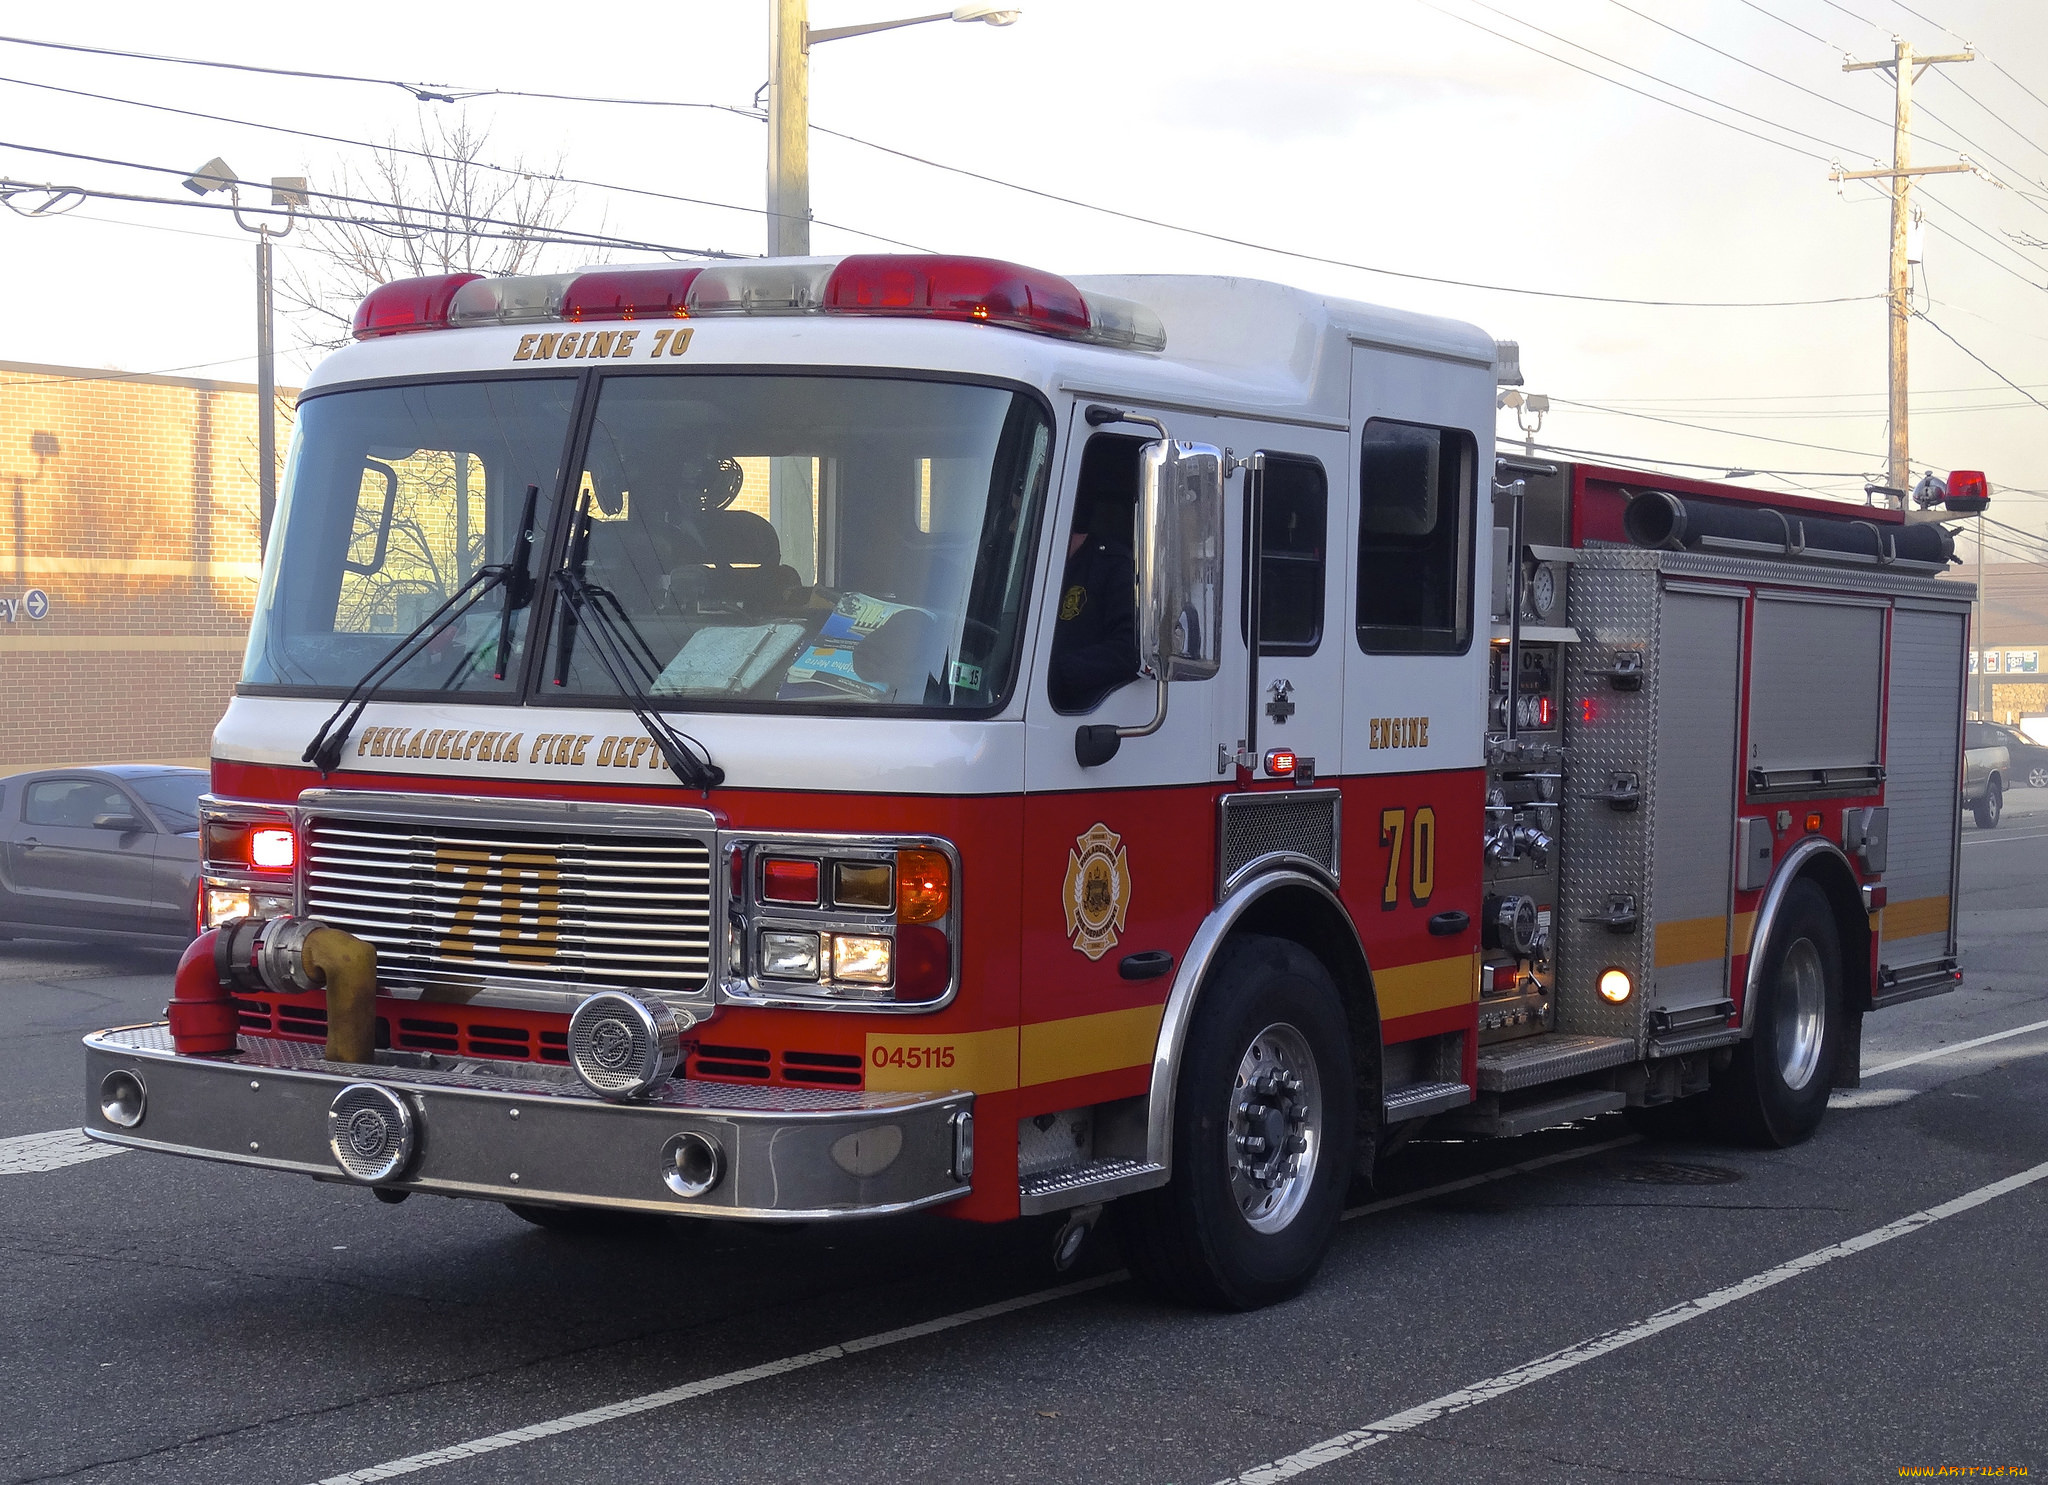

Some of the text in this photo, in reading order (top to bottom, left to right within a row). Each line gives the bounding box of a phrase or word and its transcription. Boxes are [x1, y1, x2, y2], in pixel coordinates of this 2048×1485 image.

[513, 327, 695, 361] ENGINE 70
[357, 726, 524, 763] PHILADELPHIA
[529, 733, 594, 765] FIRE
[1369, 717, 1429, 749] ENGINE
[1079, 844, 1117, 868] PHILADELPHIA
[1379, 804, 1435, 912] 70
[435, 848, 561, 966] 70
[872, 1046, 955, 1069] 045115
